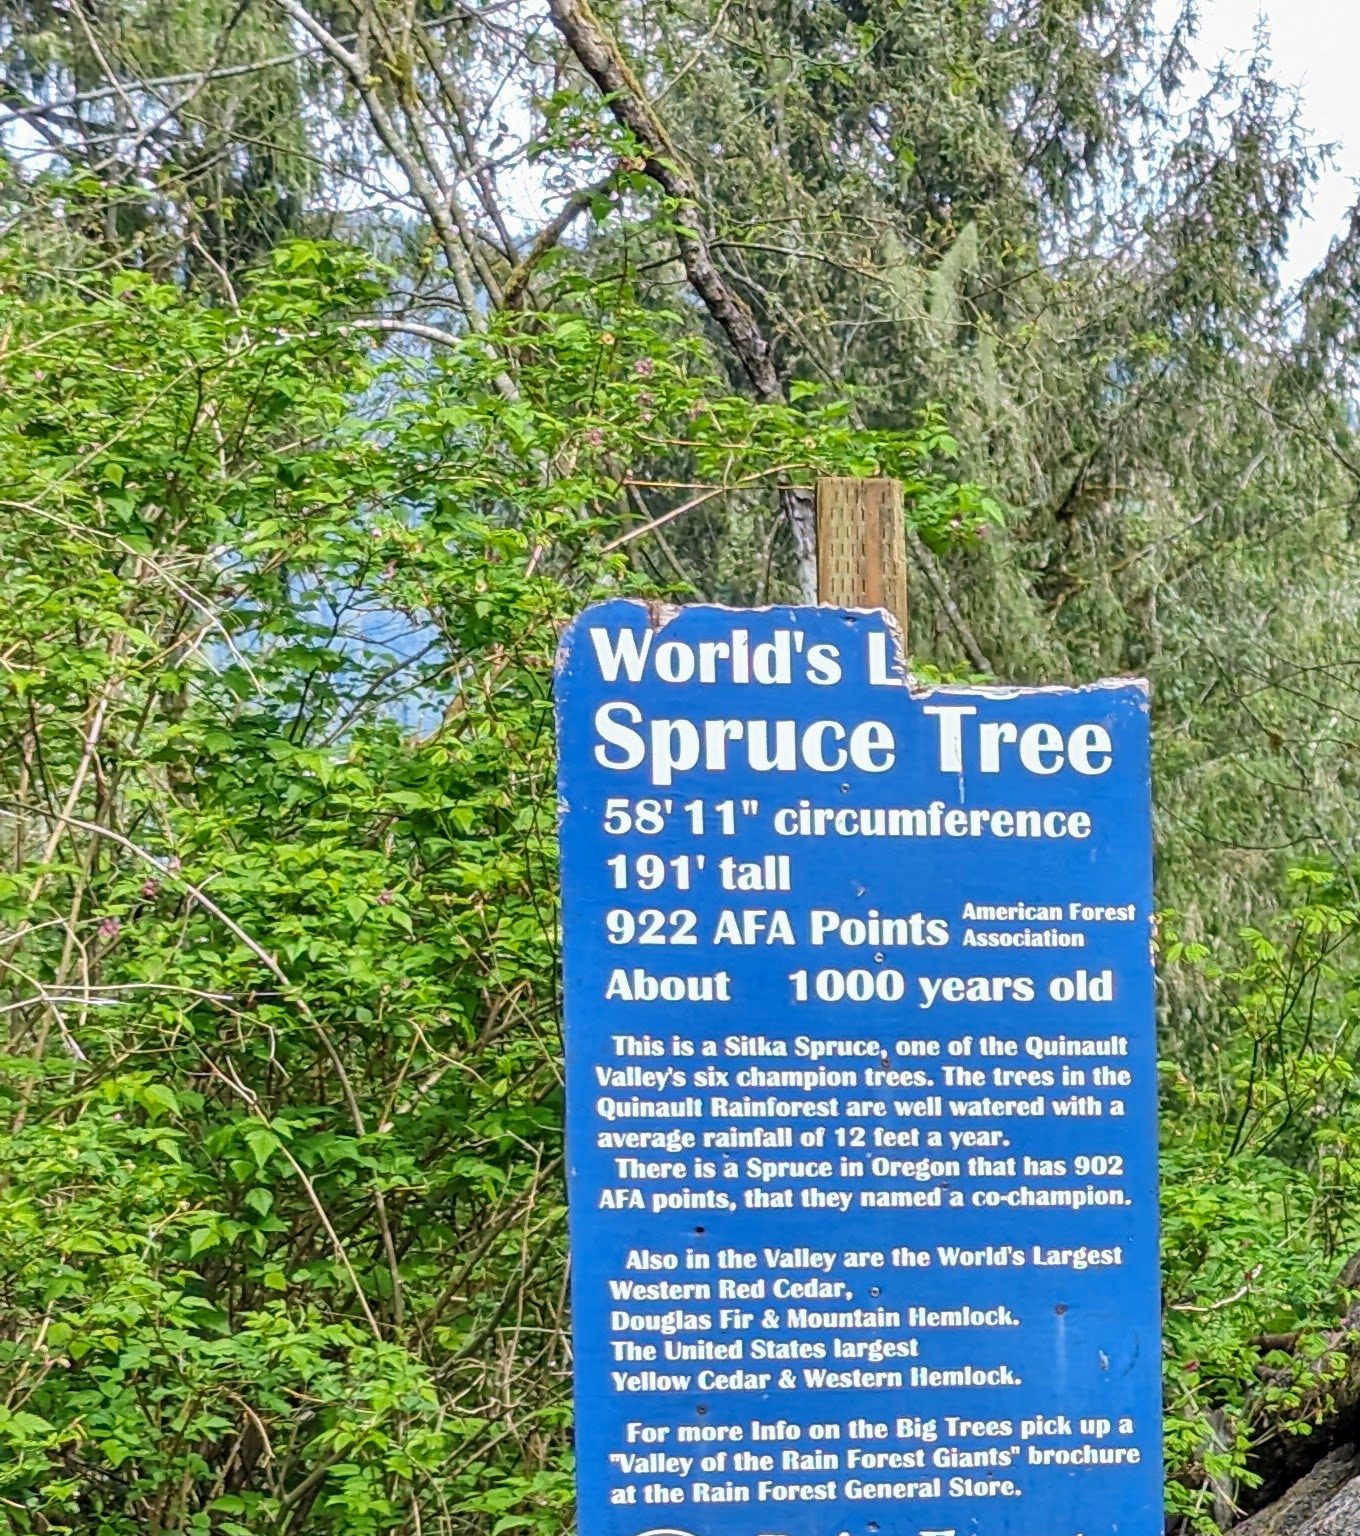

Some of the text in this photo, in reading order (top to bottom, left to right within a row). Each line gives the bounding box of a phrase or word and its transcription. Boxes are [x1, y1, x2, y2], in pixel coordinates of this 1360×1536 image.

[589, 627, 842, 686] World's
[594, 701, 1113, 786] Spruce Tree
[774, 801, 1092, 839] circumference
[607, 853, 791, 891] 191' tall
[961, 901, 1136, 921] American Forest
[606, 909, 950, 946] 922 AFA Points
[962, 927, 1085, 948] Association
[604, 968, 1113, 1009] About 1000 years old
[611, 1034, 1128, 1061] This is a Sitka Spruce, one of the Quinault
[595, 1065, 1132, 1092] Valley's six champion trees. The trees in the
[596, 1095, 1125, 1122] Quinault Rainforest are well watered with a
[597, 1126, 1011, 1153] average rainfall of 12 feet a year.
[614, 1155, 1124, 1183] There is a Spruce in Oregon that has 902
[598, 1184, 1132, 1214] AFA points, that they named a co-champion.
[625, 1245, 1123, 1273] Also in the Valley are the World's Largest
[608, 1277, 853, 1301] Western Red Cedar,
[611, 1305, 1020, 1336] Douglas Fir & Mountain Hemlock.
[610, 1337, 920, 1363] The United States largest
[610, 1365, 1022, 1392] Yellow Cedar & Western Hemlock.
[626, 1414, 1134, 1444] For more Info on the Big Trees pick up a
[608, 1444, 1141, 1478] "Valley of the Rain Forest Giants" brochure
[610, 1476, 1022, 1505] at the Rain Forest General Store.
